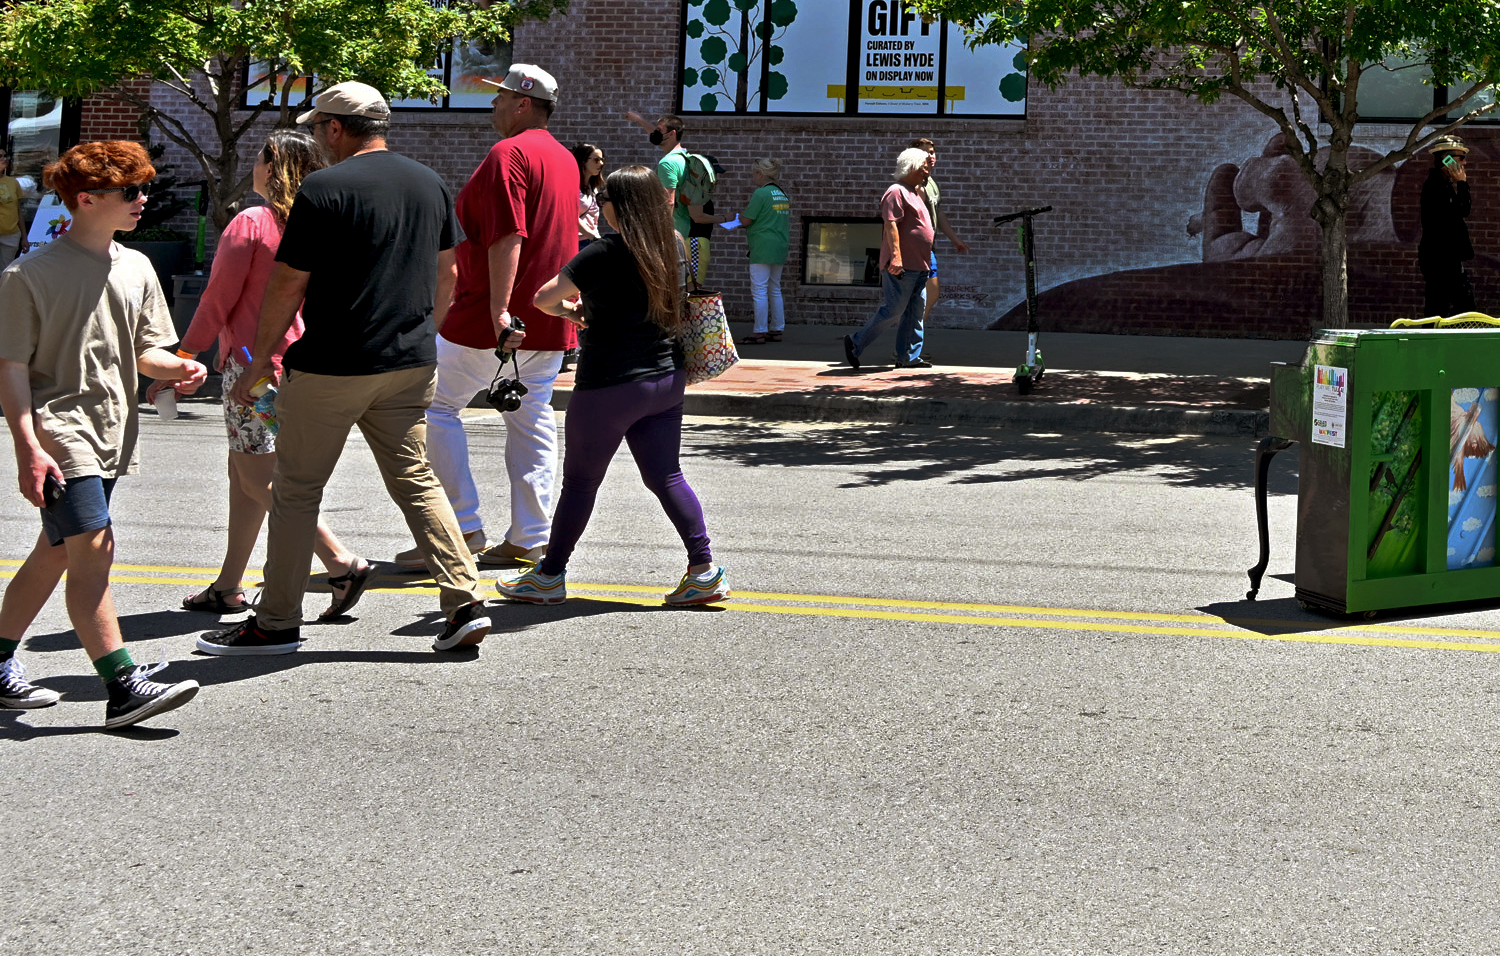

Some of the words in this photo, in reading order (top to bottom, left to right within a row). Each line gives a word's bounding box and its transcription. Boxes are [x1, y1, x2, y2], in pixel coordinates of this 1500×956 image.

[867, 40, 903, 51] CURATED
[904, 41, 915, 51] BY
[866, 52, 901, 67] LEWIS
[904, 53, 934, 68] HYDE
[865, 70, 877, 81] ON
[879, 70, 913, 81] DISPLAY
[914, 71, 934, 82] NOW
